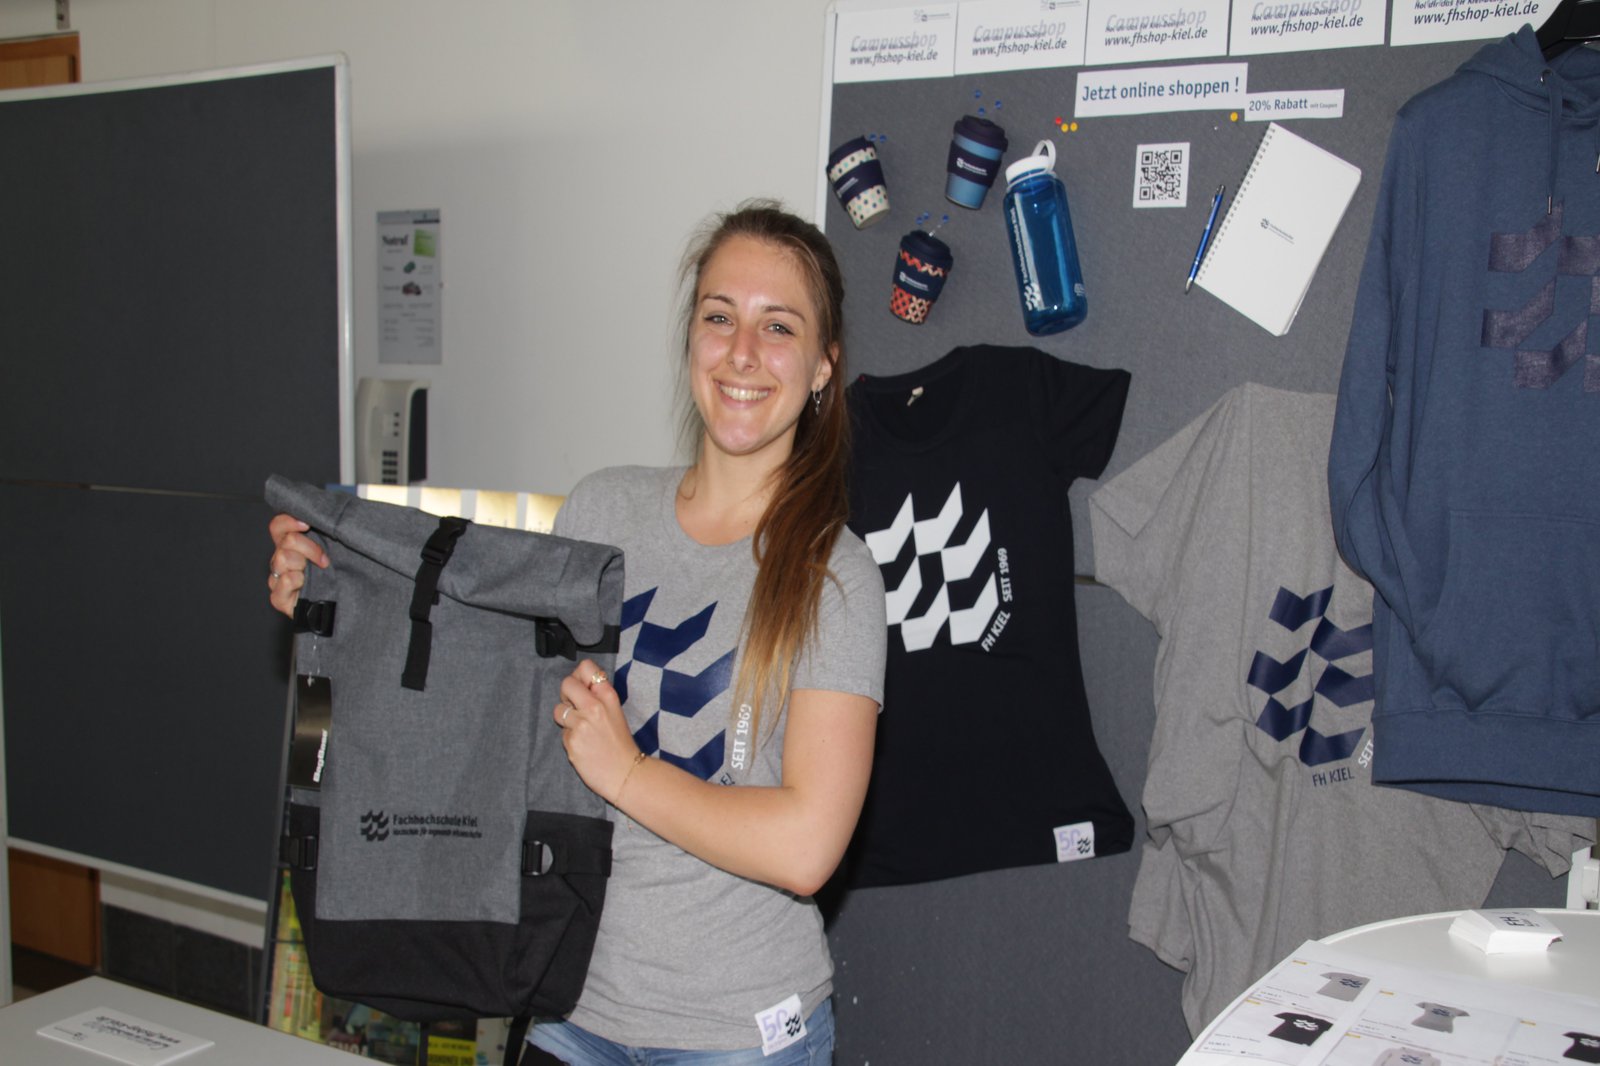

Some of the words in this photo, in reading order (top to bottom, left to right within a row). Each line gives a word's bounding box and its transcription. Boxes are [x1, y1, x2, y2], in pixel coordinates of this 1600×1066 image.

[1414, 1, 1539, 25] www.fhshop-kiel.de
[1105, 27, 1208, 47] www.fhshop-kiel.de
[1251, 15, 1364, 36] www.fhshop-kiel.de
[850, 50, 938, 66] www.fhshop-kiel.de
[972, 38, 1067, 56] www.fhshop-kiel.de
[1082, 84, 1117, 101] Jetzt
[1120, 82, 1165, 99] online
[1168, 79, 1229, 98] shoppen
[1233, 77, 1239, 93] !
[1249, 100, 1271, 111] 20%
[1274, 98, 1308, 110] Rabatt
[997, 547, 1009, 575] 1969
[1000, 577, 1013, 602] SEIT
[981, 633, 996, 652] FH
[990, 610, 1011, 637] KIEL
[736, 703, 752, 736] 1969
[731, 738, 747, 770] SEIT
[1312, 772, 1327, 787] FH
[1329, 766, 1355, 784] KIEL
